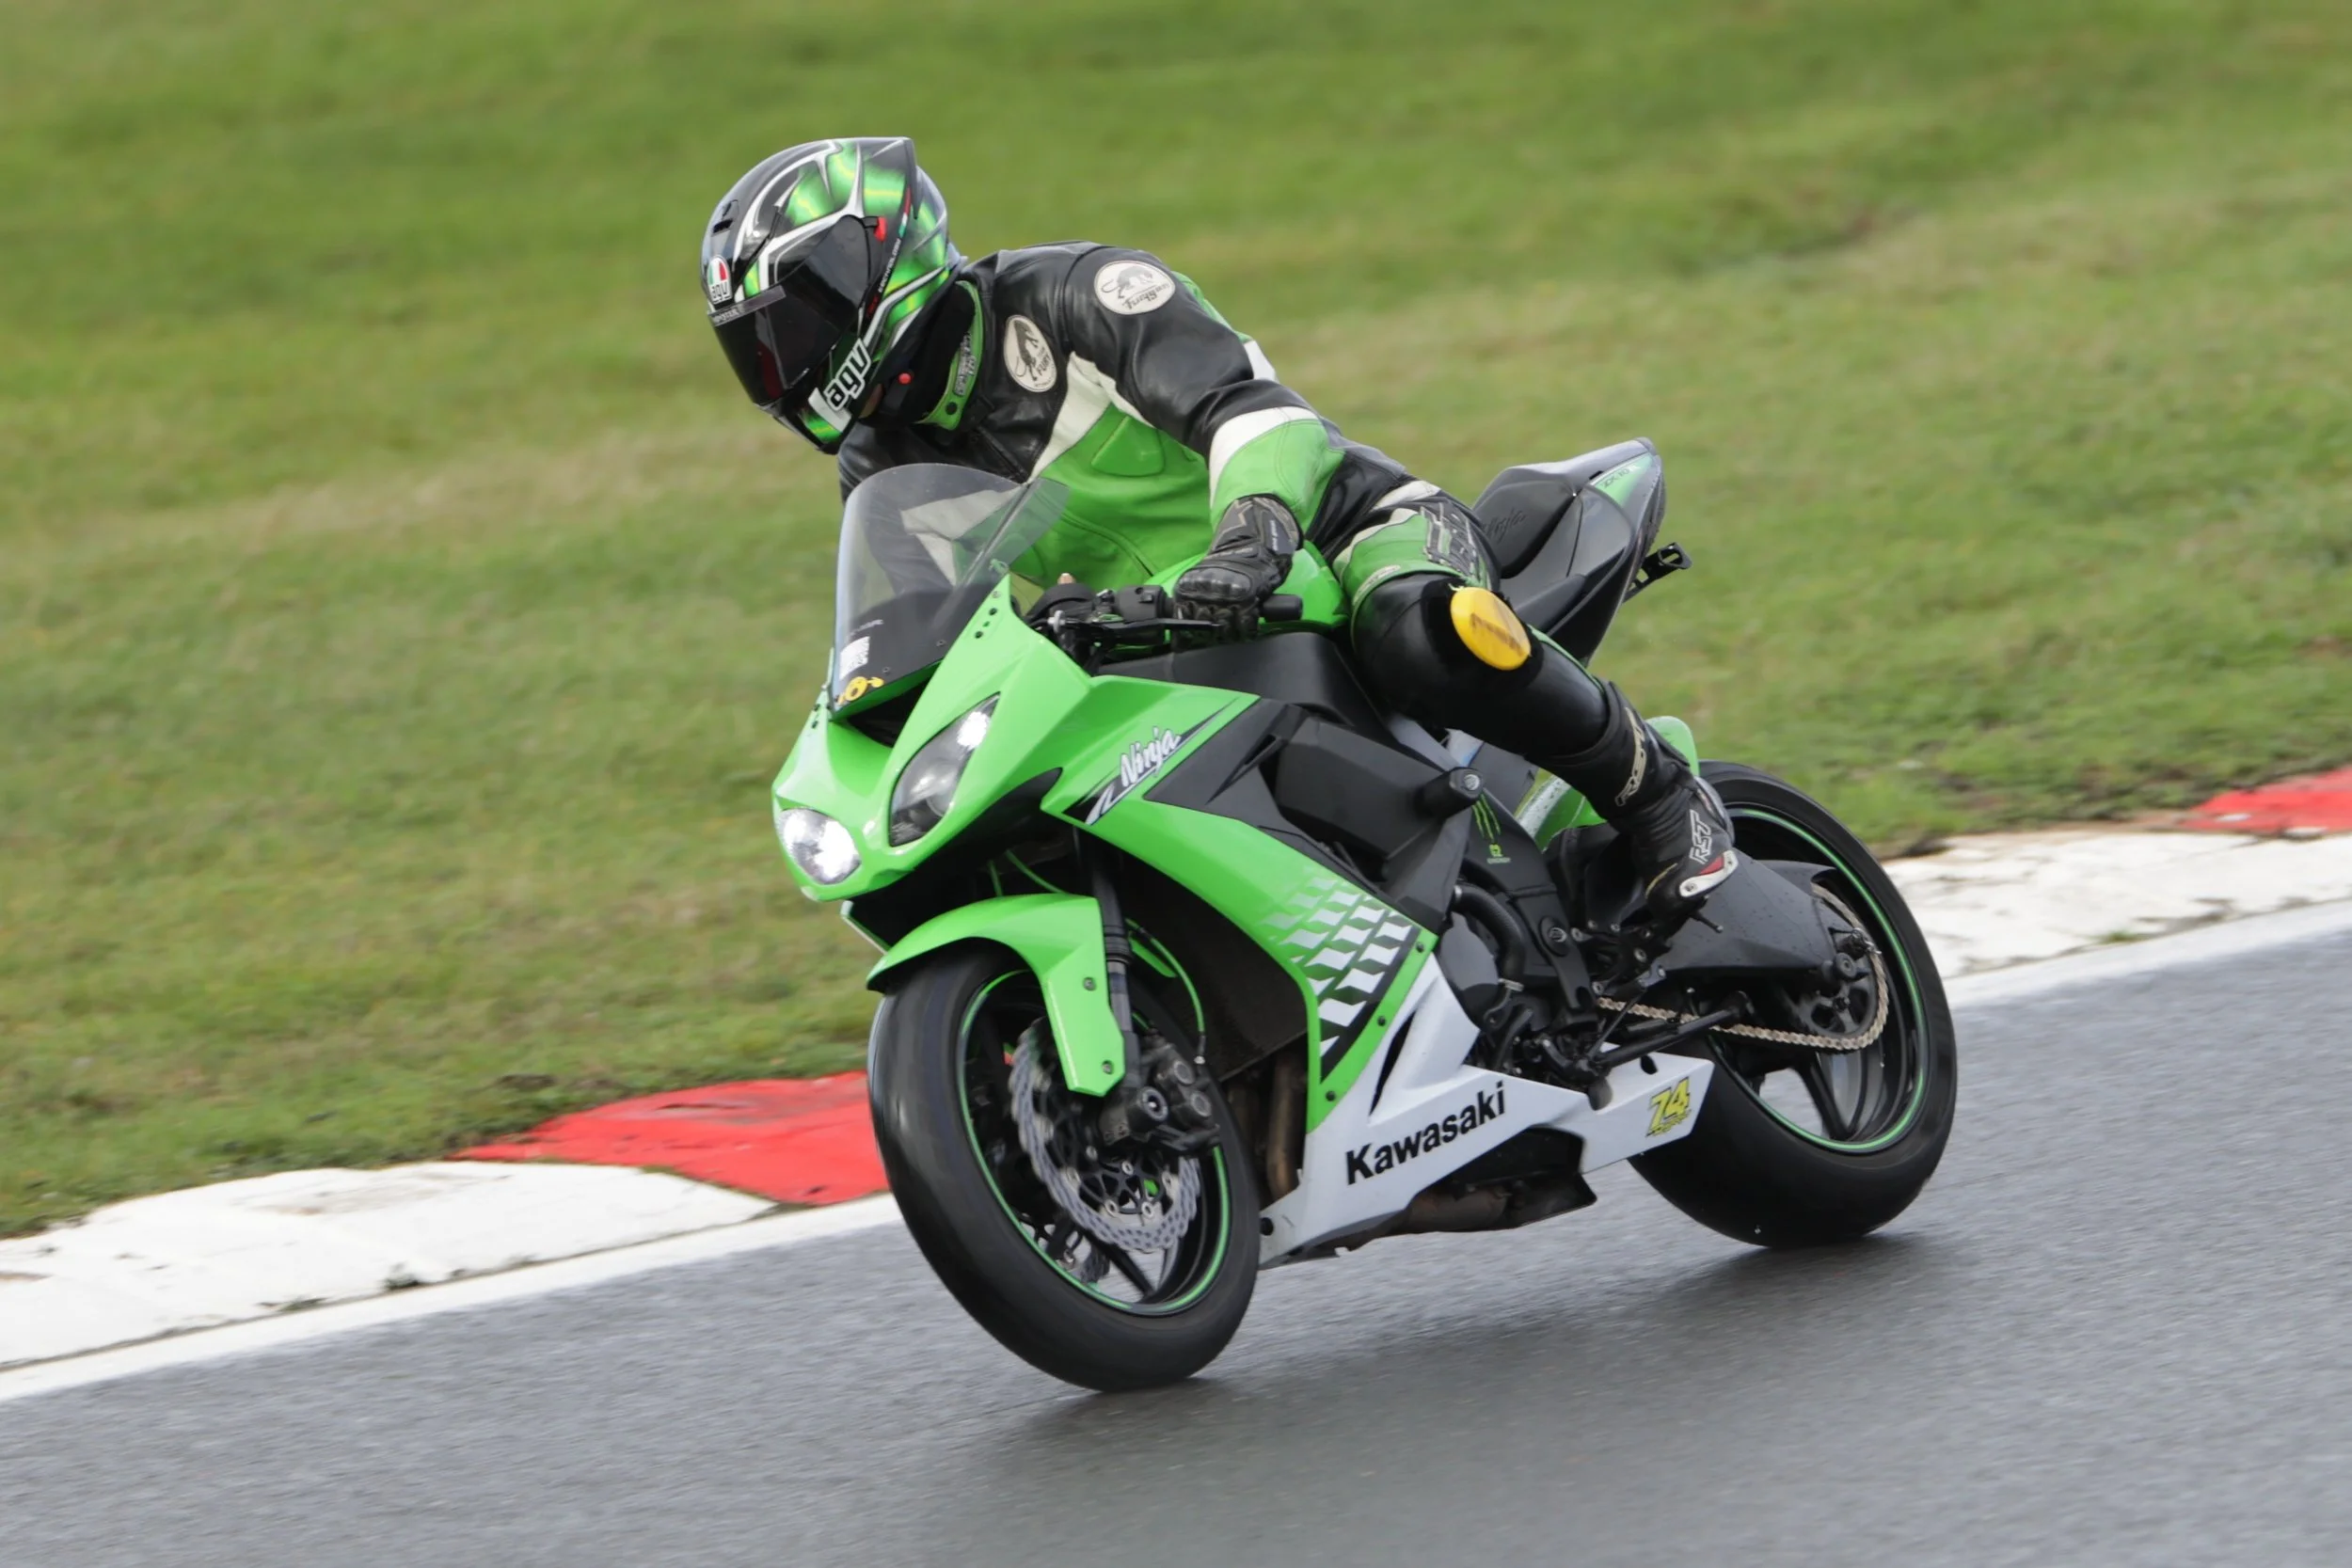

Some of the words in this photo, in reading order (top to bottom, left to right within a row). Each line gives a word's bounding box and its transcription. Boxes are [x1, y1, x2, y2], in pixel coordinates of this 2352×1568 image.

[823, 338, 872, 411] agv
[1119, 725, 1183, 789] Ninja
[1689, 809, 1713, 864] RST
[1345, 1080, 1505, 1186] Kawasaki
[1646, 1076, 1691, 1137] 74
